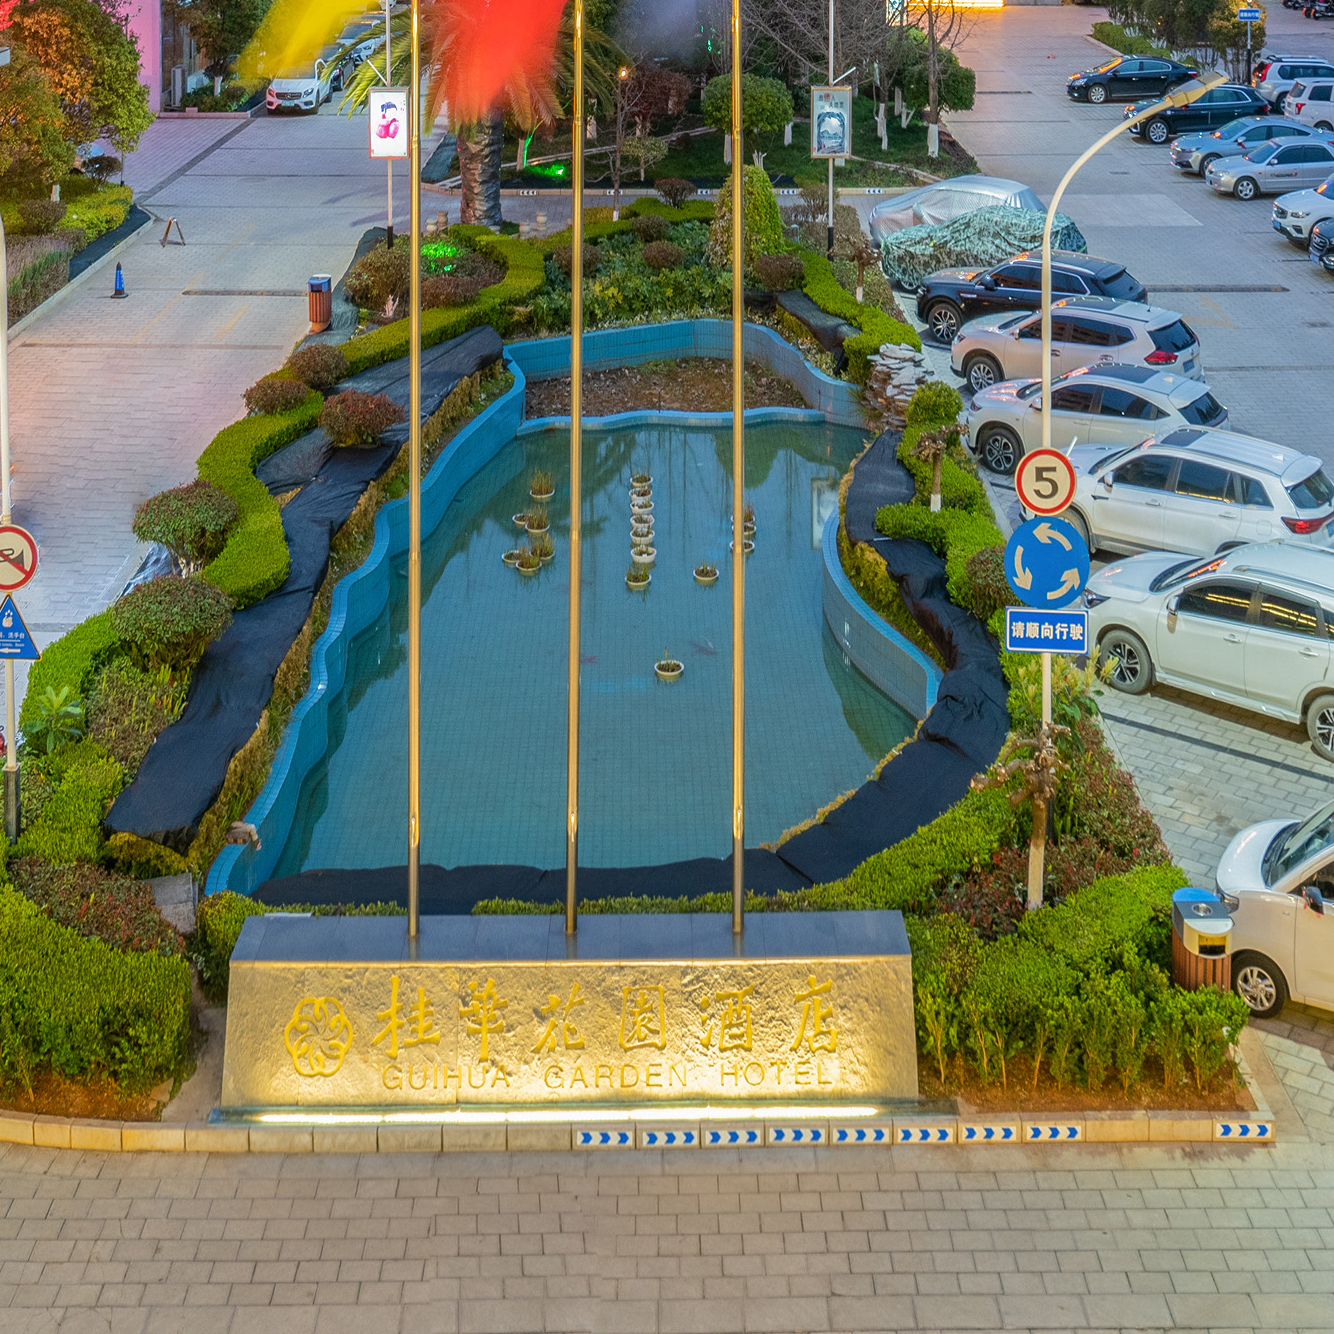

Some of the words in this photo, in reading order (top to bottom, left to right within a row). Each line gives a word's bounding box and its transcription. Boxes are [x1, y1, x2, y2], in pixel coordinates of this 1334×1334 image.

[1033, 466, 1059, 499] 5
[1011, 621, 1084, 641] 请顺向行驶
[382, 1063, 511, 1090] GUIHUA
[544, 1063, 687, 1090] GARDEN
[721, 1060, 833, 1086] HOTEL
